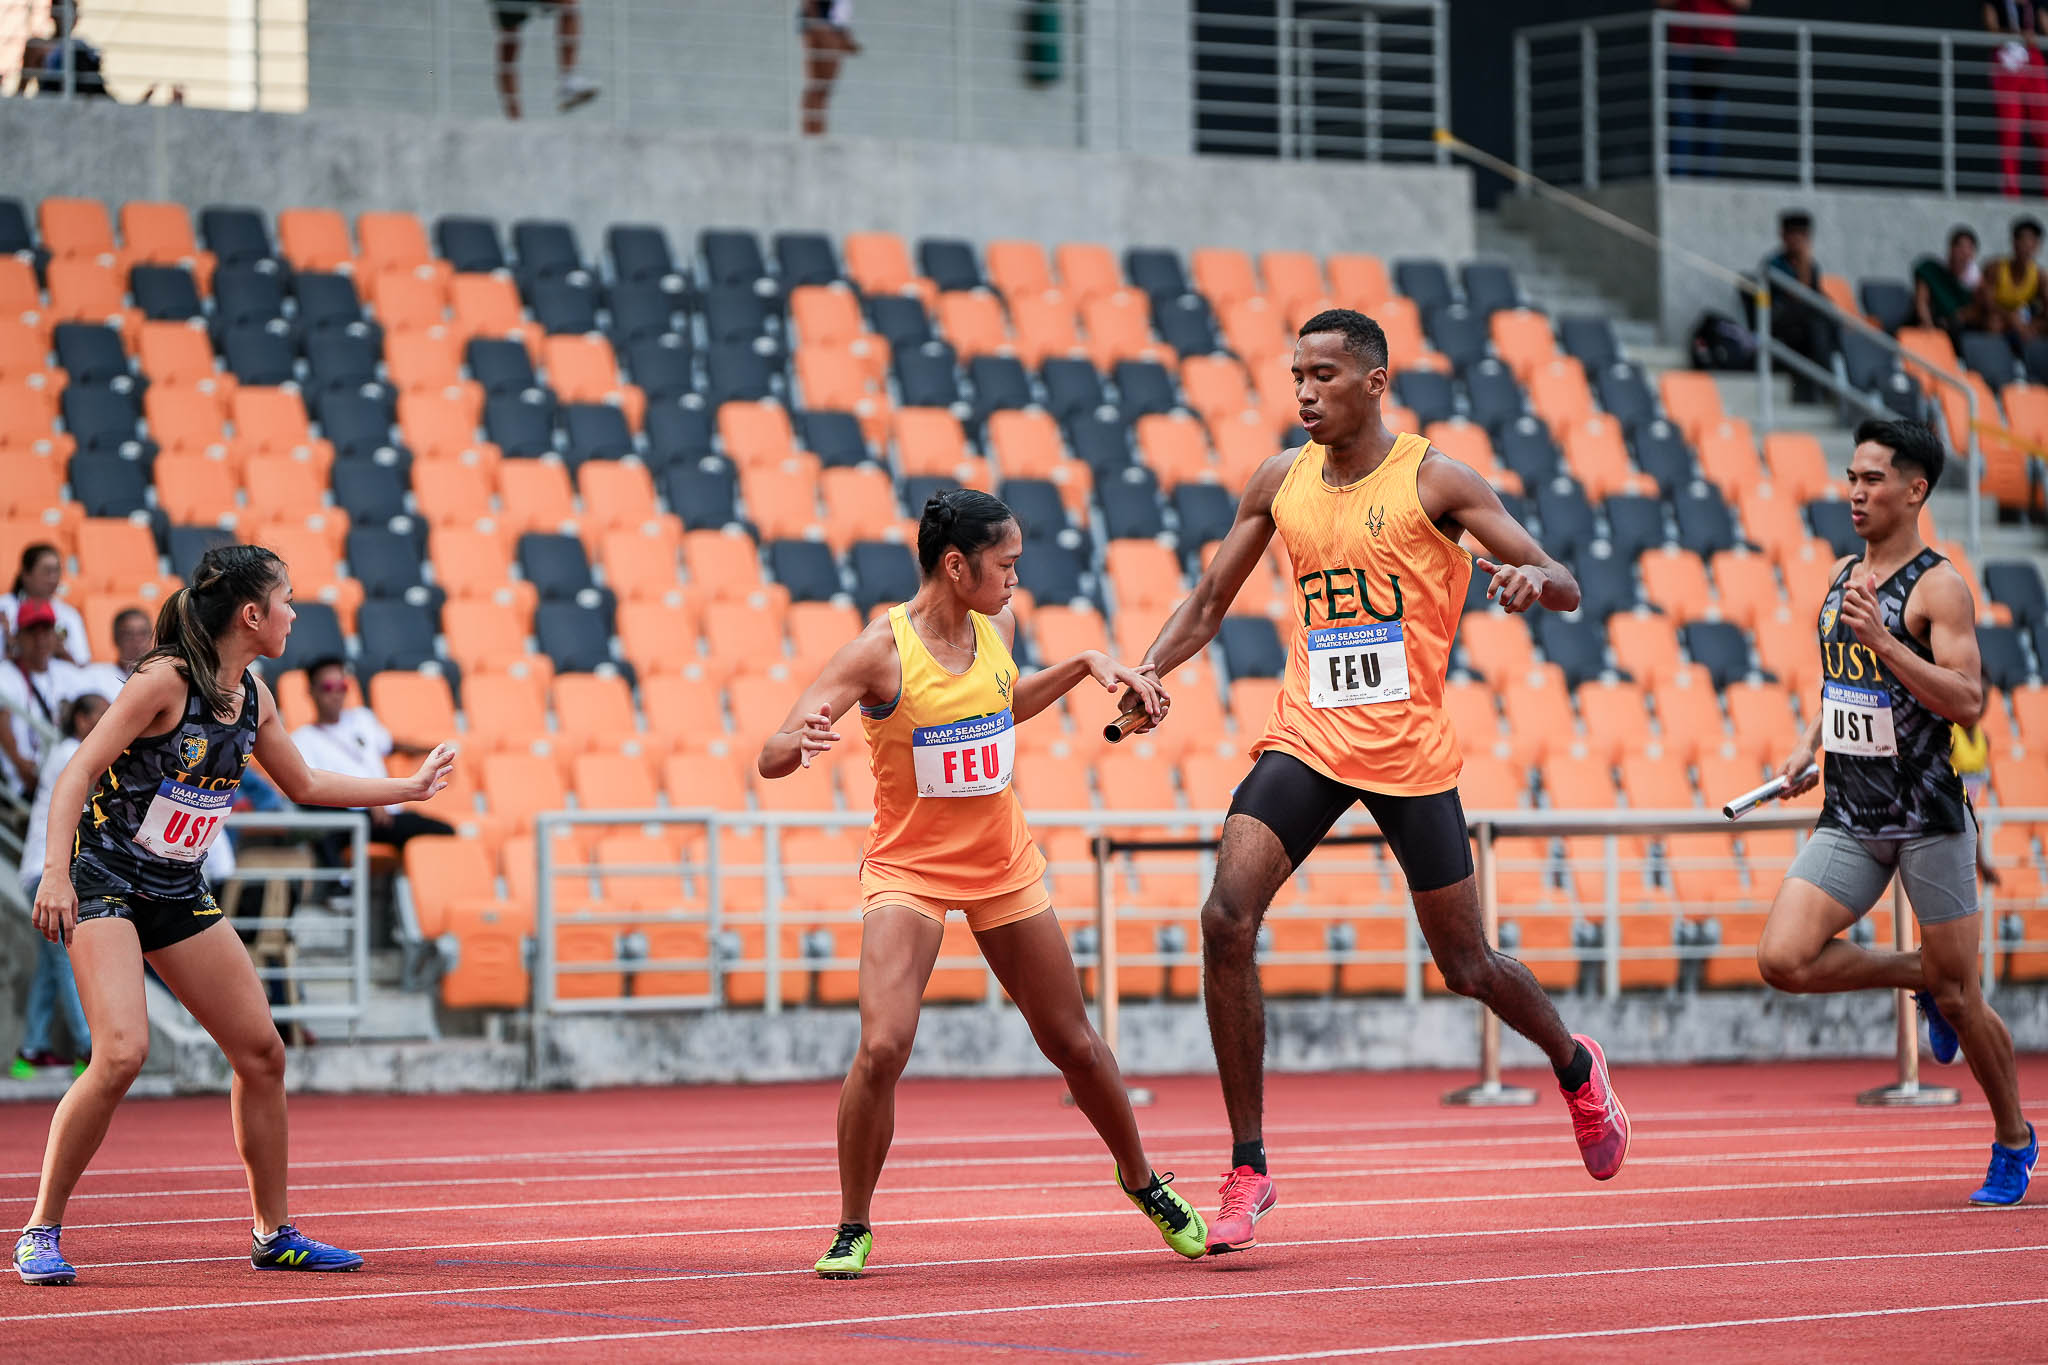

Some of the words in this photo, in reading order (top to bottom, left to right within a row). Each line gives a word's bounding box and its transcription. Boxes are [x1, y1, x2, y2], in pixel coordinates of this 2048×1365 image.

[1298, 567, 1403, 627] FEU
[1314, 633, 1336, 643] UAAP
[1337, 629, 1374, 641] SEASON
[1375, 627, 1388, 637] 87
[1315, 641, 1341, 649] ATHLETICS
[1342, 636, 1388, 646] CHAMPIONSHIPS
[1328, 652, 1382, 692] FEU
[1824, 642, 1883, 681] UST
[923, 729, 953, 740] UAAP
[954, 720, 995, 736] SEASON
[996, 716, 1005, 727] 87
[925, 736, 960, 745] ATHLETICS
[1834, 709, 1873, 743] UST
[943, 743, 999, 784] FEU
[169, 793, 200, 807] ATHLETICS
[171, 785, 199, 800] UAAP
[163, 810, 218, 847] UST
